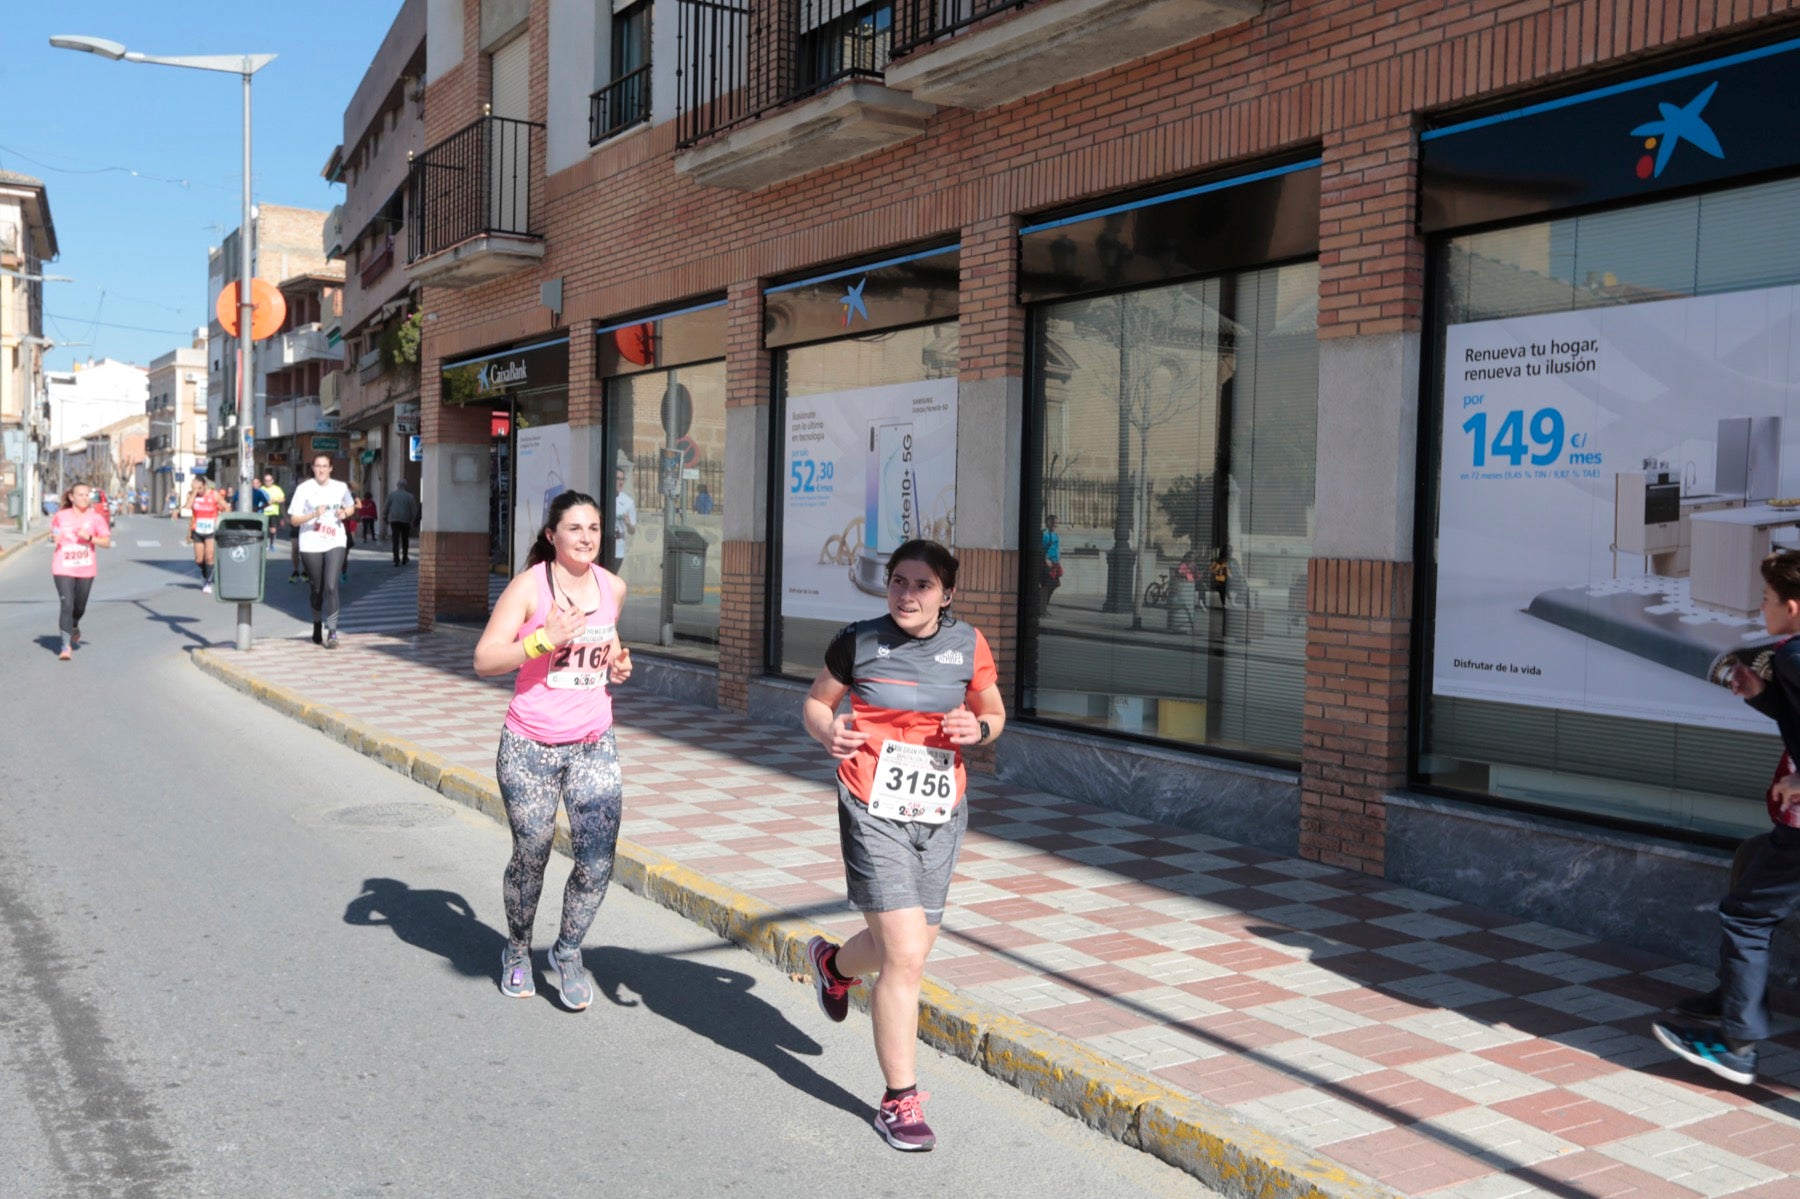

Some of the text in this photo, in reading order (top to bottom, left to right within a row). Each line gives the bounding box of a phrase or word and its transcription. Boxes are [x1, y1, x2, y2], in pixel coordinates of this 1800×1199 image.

[1465, 339, 1599, 362] Renueva tu hogar,
[490, 358, 527, 384] CaixaBank
[1464, 356, 1596, 381] renueva tu ilusión
[1463, 393, 1485, 409] por
[902, 433, 912, 462] 5G
[1462, 407, 1565, 467] 149
[1570, 432, 1588, 448] €/
[1569, 452, 1602, 465] mes
[64, 550, 89, 560] 2209
[554, 644, 611, 669] 2162
[1453, 658, 1542, 676] Disfrutar de la vida
[885, 766, 951, 799] 3156
